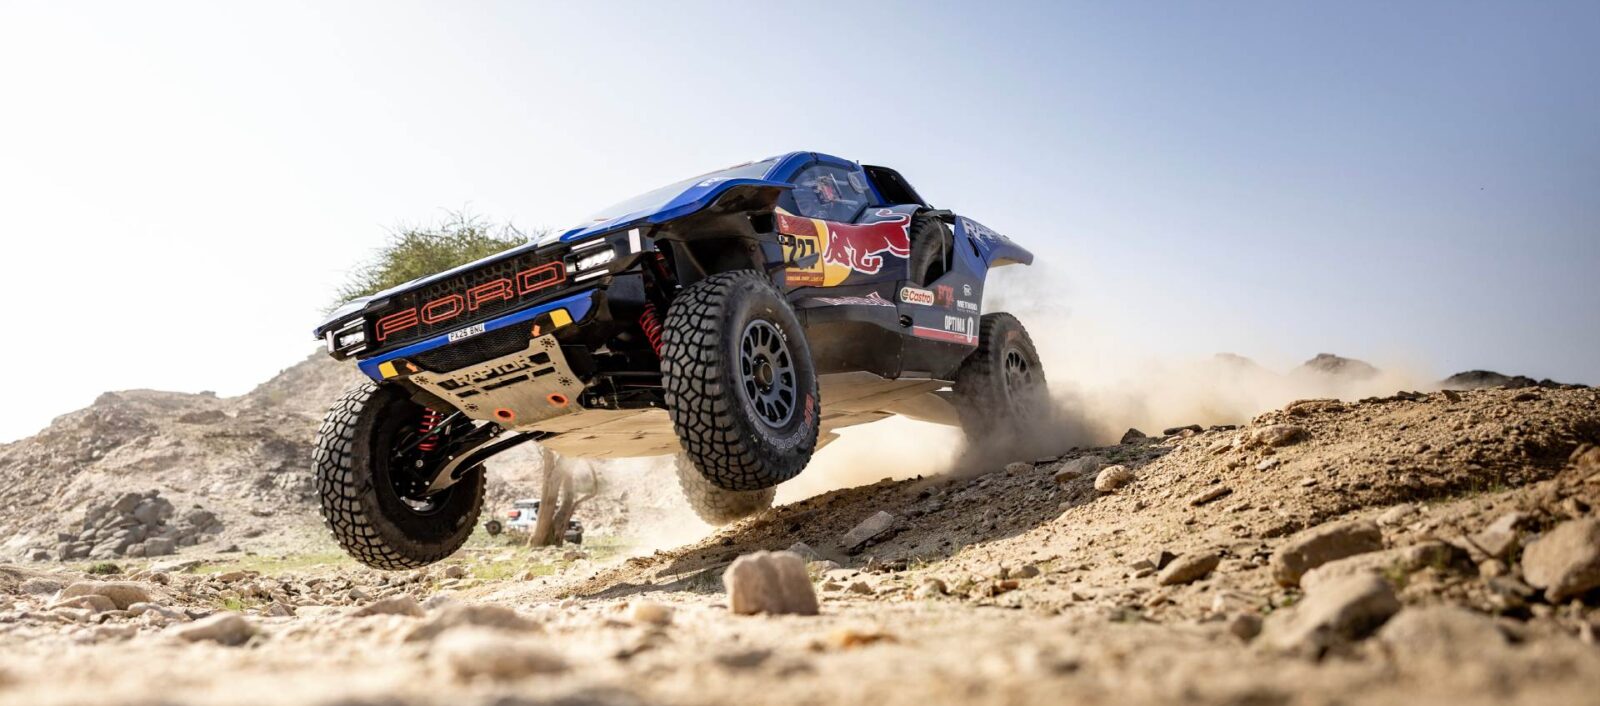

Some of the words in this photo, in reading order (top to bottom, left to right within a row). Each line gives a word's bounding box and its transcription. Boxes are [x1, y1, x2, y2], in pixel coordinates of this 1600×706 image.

[376, 261, 566, 341] FORD
[909, 290, 933, 304] Castrol
[945, 315, 965, 333] OPTIMA
[456, 357, 533, 386] RAPTOR
